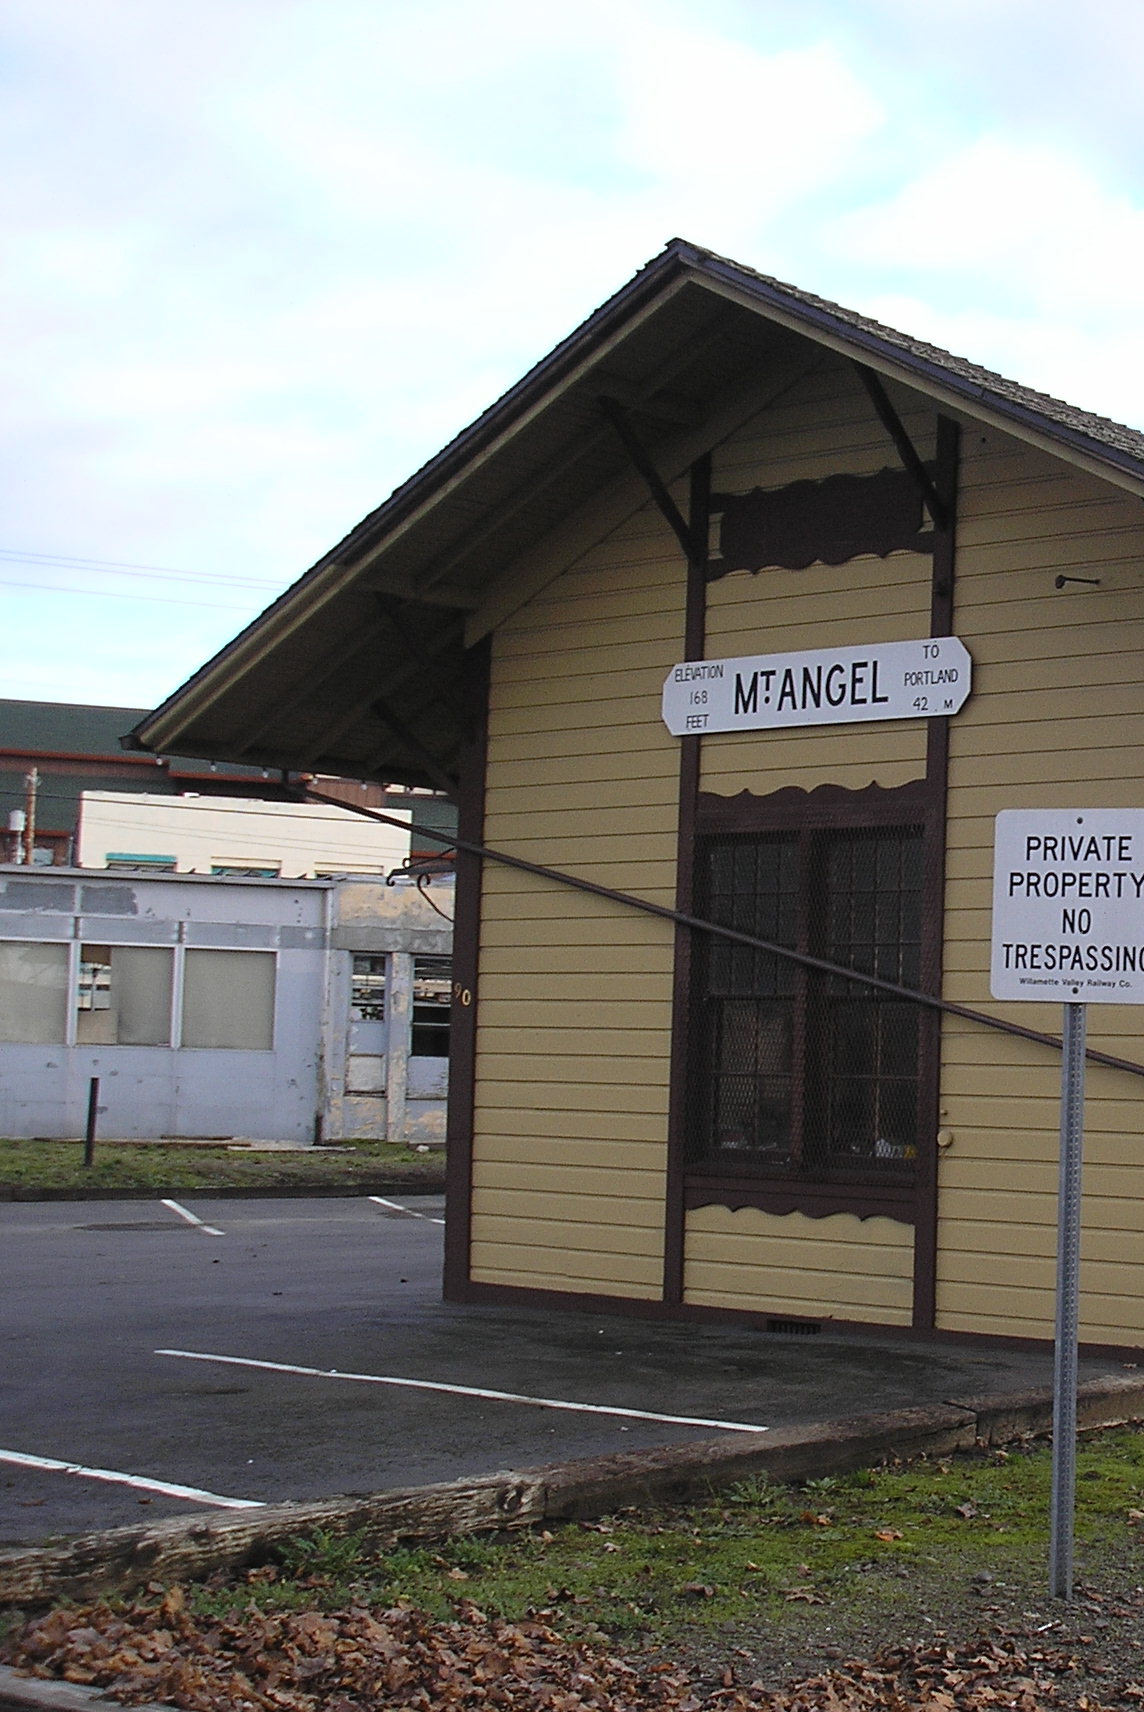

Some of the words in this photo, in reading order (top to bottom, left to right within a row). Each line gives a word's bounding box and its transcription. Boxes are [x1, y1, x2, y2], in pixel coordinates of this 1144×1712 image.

[922, 644, 940, 659] TO
[675, 665, 724, 682] ELEVATION
[904, 668, 959, 687] PORTLAND
[777, 660, 889, 711] ANGEL
[690, 690, 708, 705] 168
[913, 697, 928, 711] 42
[686, 714, 710, 729] FEET
[1026, 836, 1133, 861] PRIVATE
[1062, 908, 1092, 934] NO
[1019, 977, 1059, 986] Willamette
[1062, 979, 1084, 988] Valley
[1087, 979, 1116, 989] Railway
[1119, 980, 1133, 989] Co.
